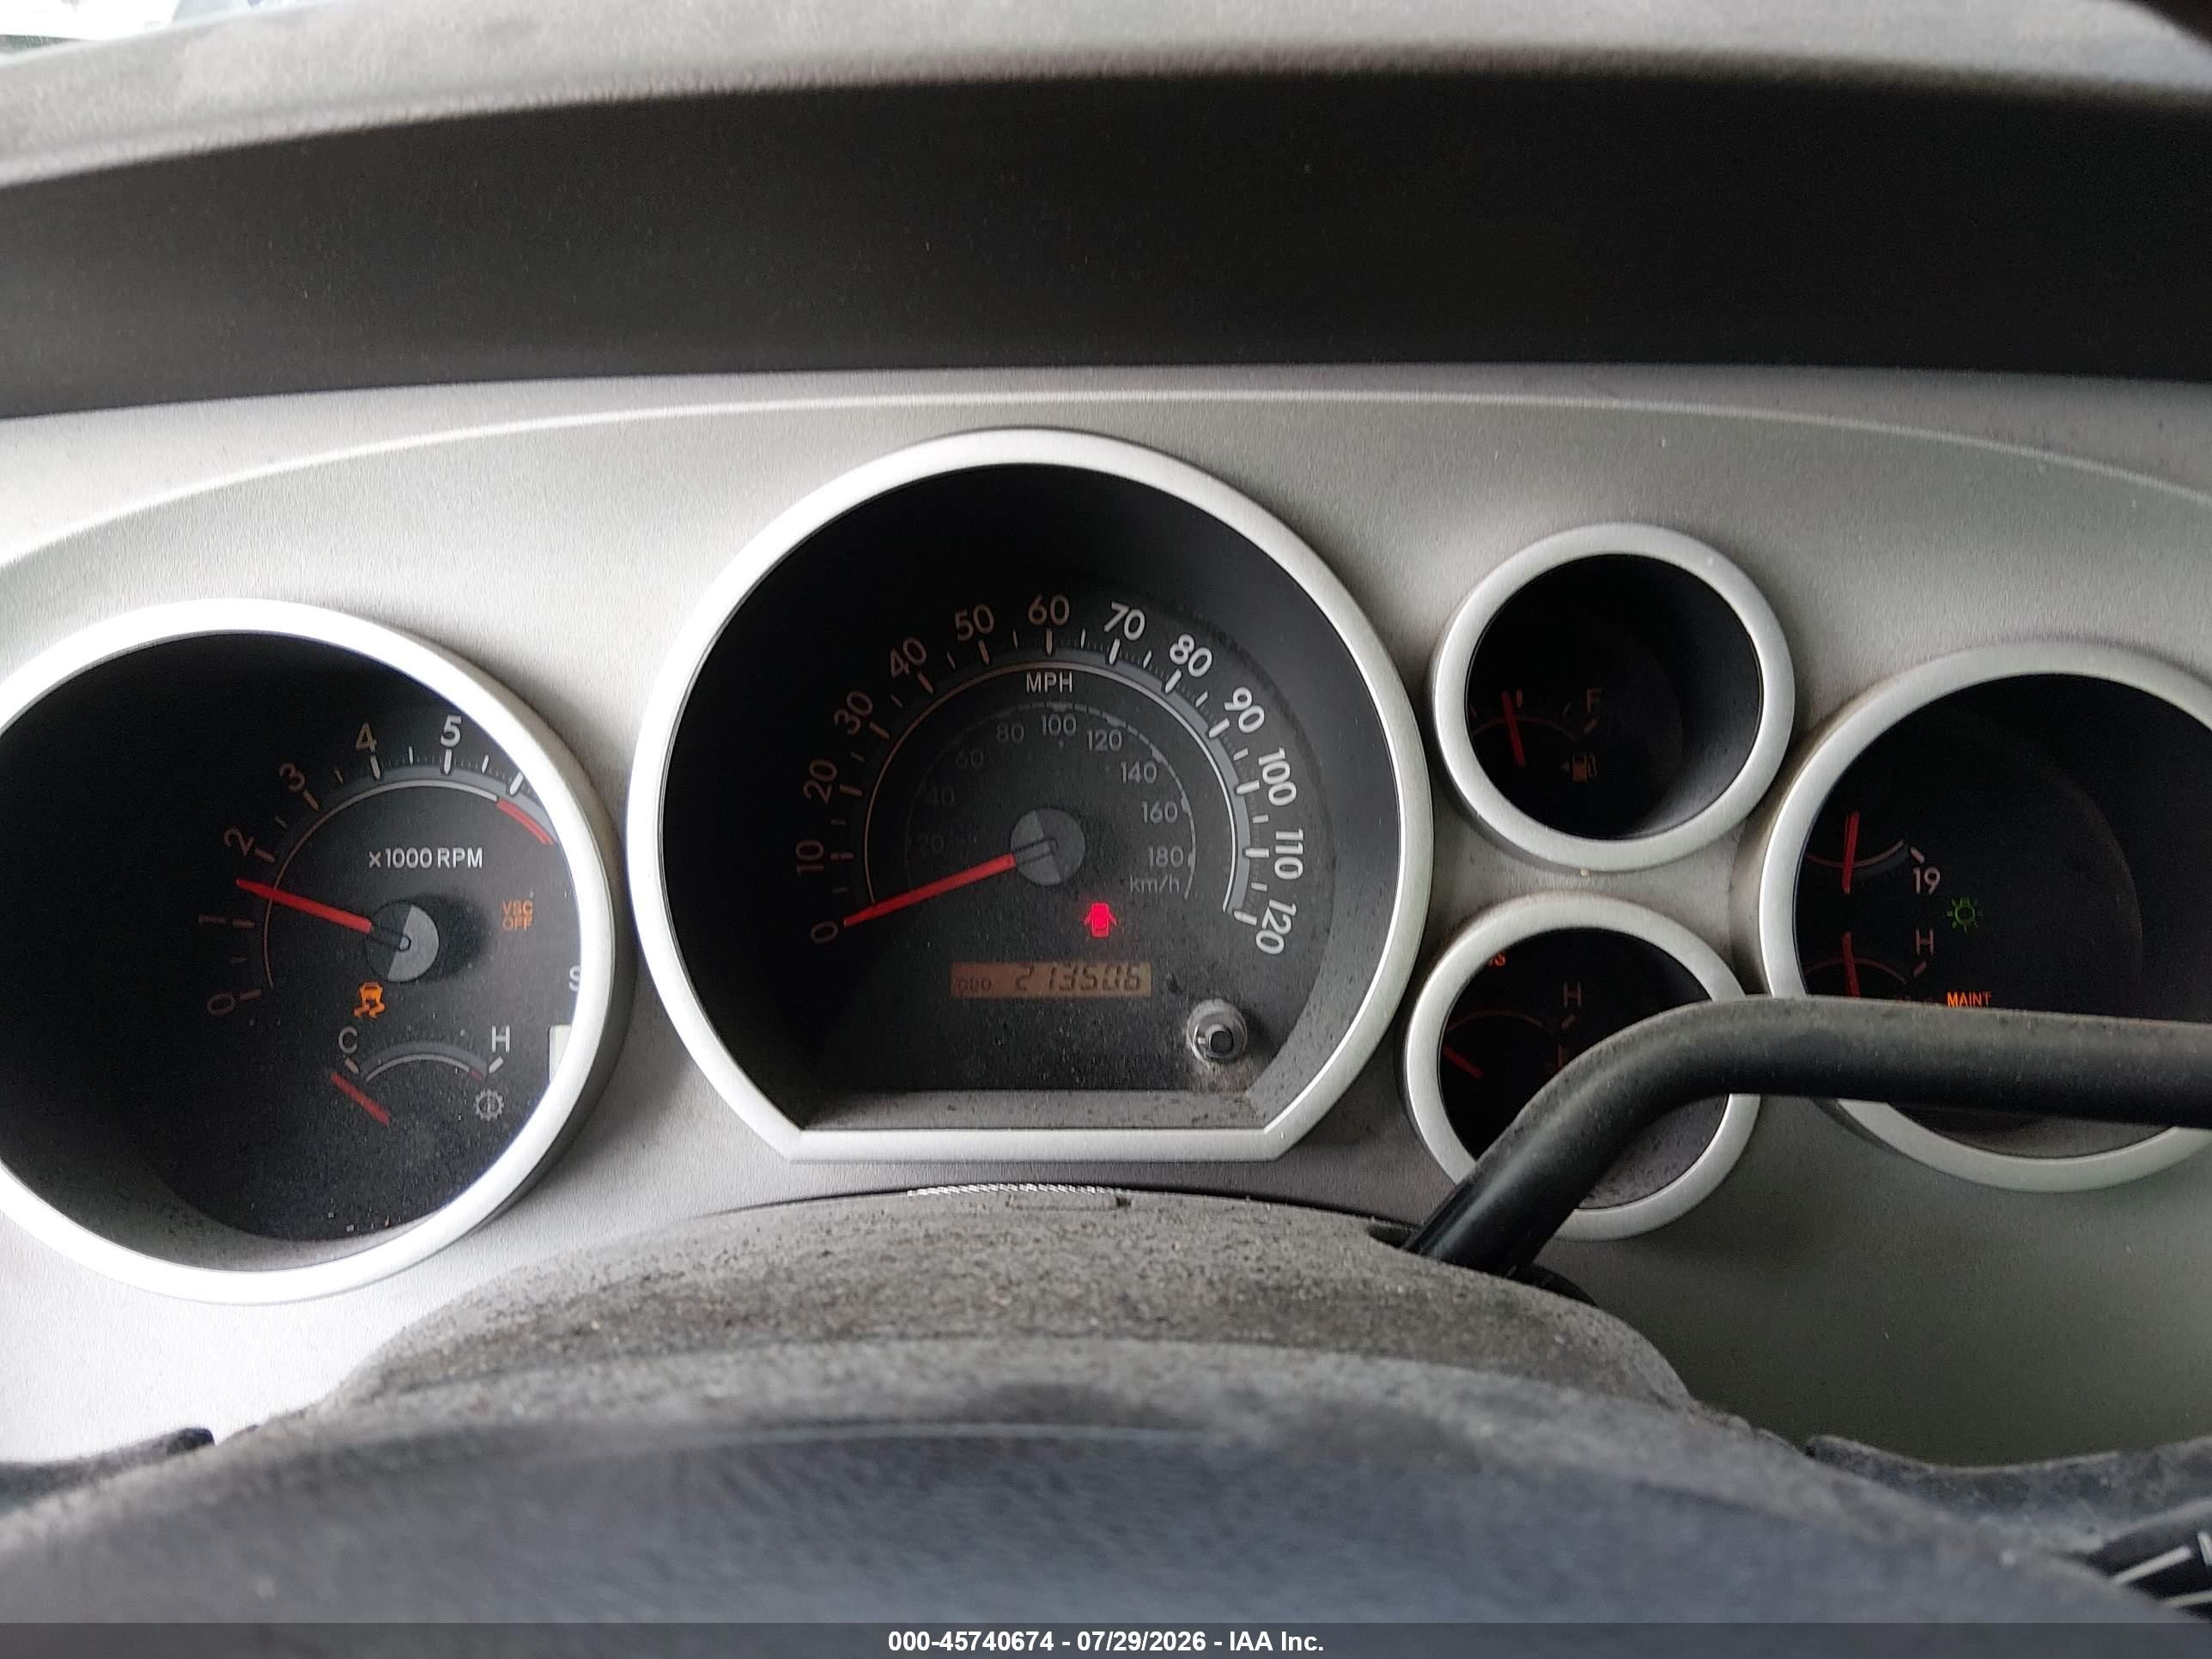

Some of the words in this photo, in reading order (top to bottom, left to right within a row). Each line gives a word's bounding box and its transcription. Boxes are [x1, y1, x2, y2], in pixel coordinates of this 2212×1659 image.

[954, 605, 995, 636] 50
[1028, 593, 1069, 624] 60
[1104, 603, 1146, 640] 70
[888, 637, 928, 677] 40
[1170, 634, 1212, 677] 80
[1026, 672, 1073, 693] MPH
[833, 690, 874, 735] 30
[1040, 714, 1077, 736] 100
[1224, 688, 1265, 734] 90
[356, 722, 378, 752] 4
[440, 715, 462, 744] 5
[1086, 729, 1122, 751] 120
[278, 763, 307, 792] 3
[802, 757, 838, 802] 20
[1120, 761, 1158, 784] 140
[1258, 747, 1297, 806] 100
[1140, 801, 1178, 823] 160
[223, 827, 255, 857] 2
[1147, 845, 1184, 868] 180
[1274, 829, 1304, 880] 110
[437, 847, 483, 869] RPM
[795, 841, 825, 875] 10
[1129, 875, 1181, 893] km/h
[1912, 866, 1942, 895] 19
[198, 915, 226, 926] 1
[810, 921, 839, 944] 0
[1255, 899, 1297, 955] 120
[1914, 927, 1936, 955] H
[206, 994, 237, 1017] 0
[1563, 981, 1583, 1008] H
[1946, 990, 1991, 1008] MAINT
[337, 1025, 358, 1054] C
[491, 1024, 511, 1054] H
